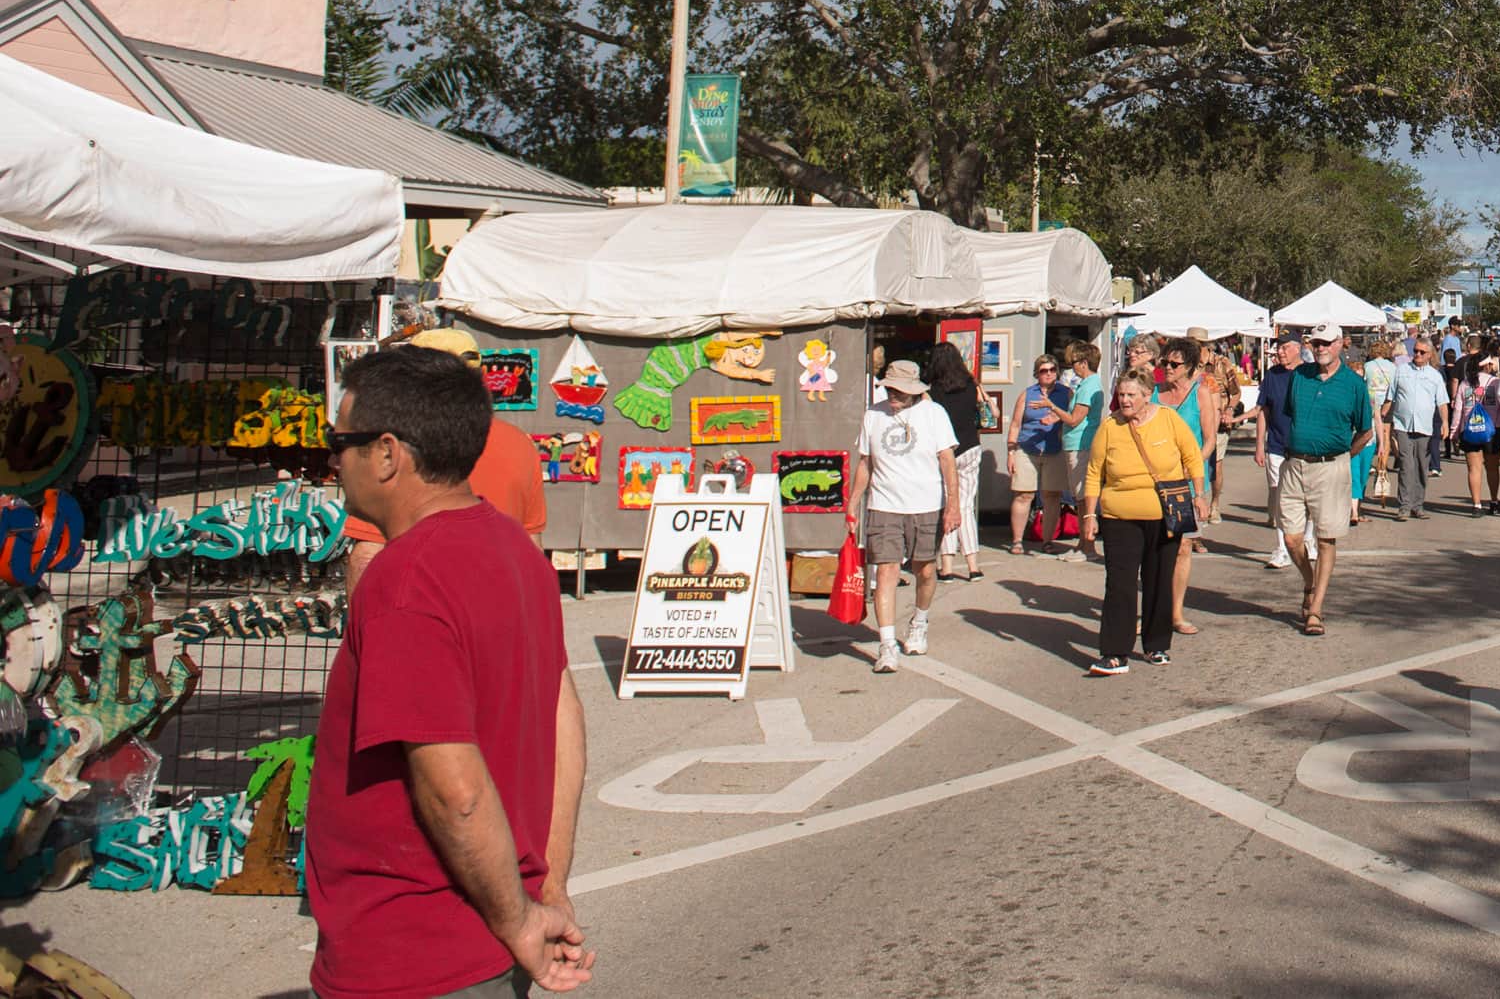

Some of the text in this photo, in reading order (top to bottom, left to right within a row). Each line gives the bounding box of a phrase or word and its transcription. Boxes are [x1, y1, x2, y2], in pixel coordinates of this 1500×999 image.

[672, 509, 745, 532] OPEN
[650, 575, 745, 589] PINEAPPLE JACK'S
[676, 592, 713, 600] BISTRO
[666, 609, 718, 621] VOTED #1
[642, 626, 738, 639] TASTE OF JENSEN
[635, 649, 736, 670] 772-444-3550
